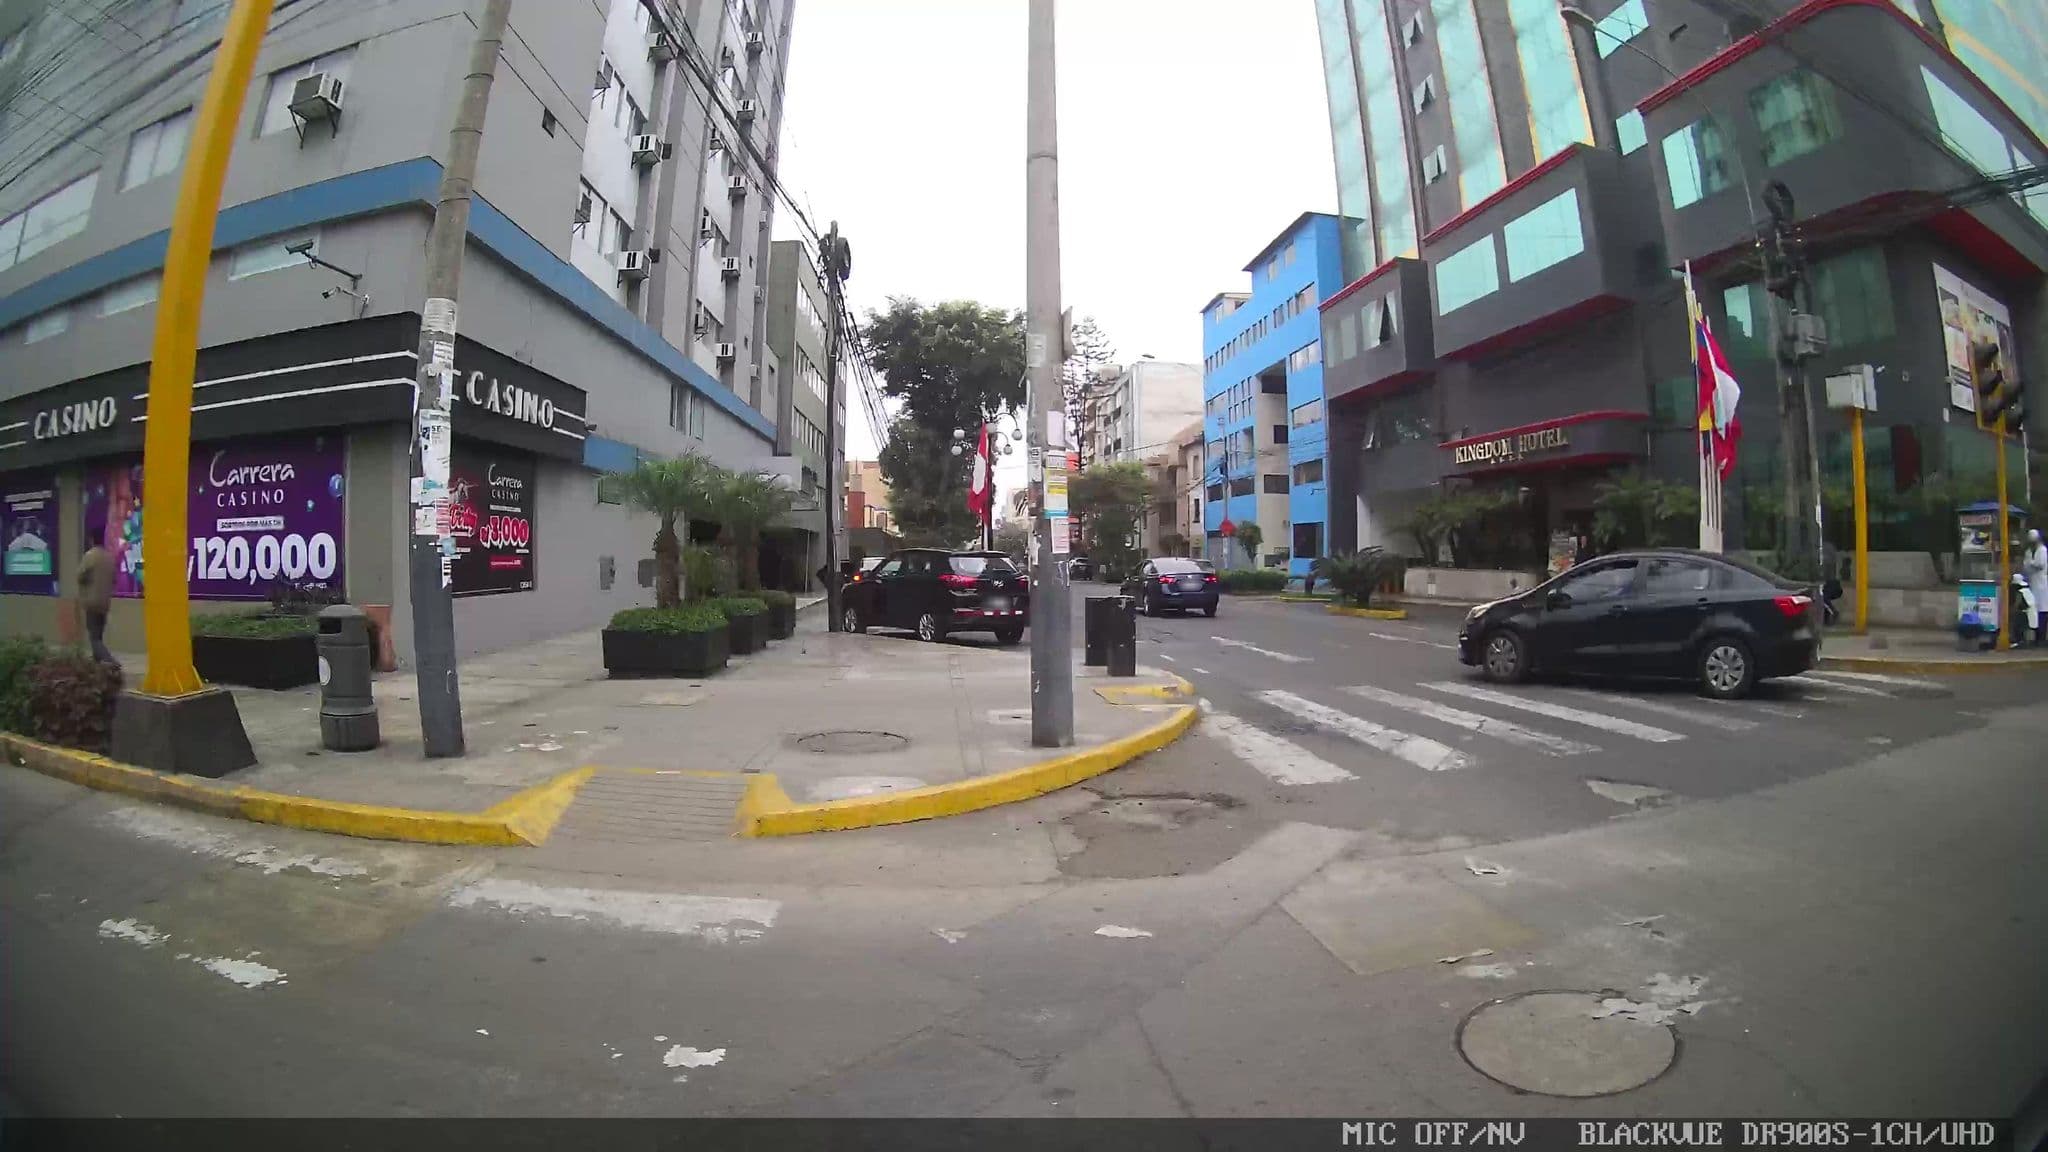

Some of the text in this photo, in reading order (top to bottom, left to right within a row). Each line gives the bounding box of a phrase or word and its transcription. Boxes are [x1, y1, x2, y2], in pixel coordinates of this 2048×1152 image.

[34, 396, 117, 440] CASINO
[466, 370, 554, 429] CASINO
[1455, 427, 1569, 464] KINGDOM HOTEL
[209, 450, 295, 487] Carrera
[488, 463, 523, 489] Carrera
[217, 489, 285, 508] CASINO
[491, 489, 520, 501] CASINO
